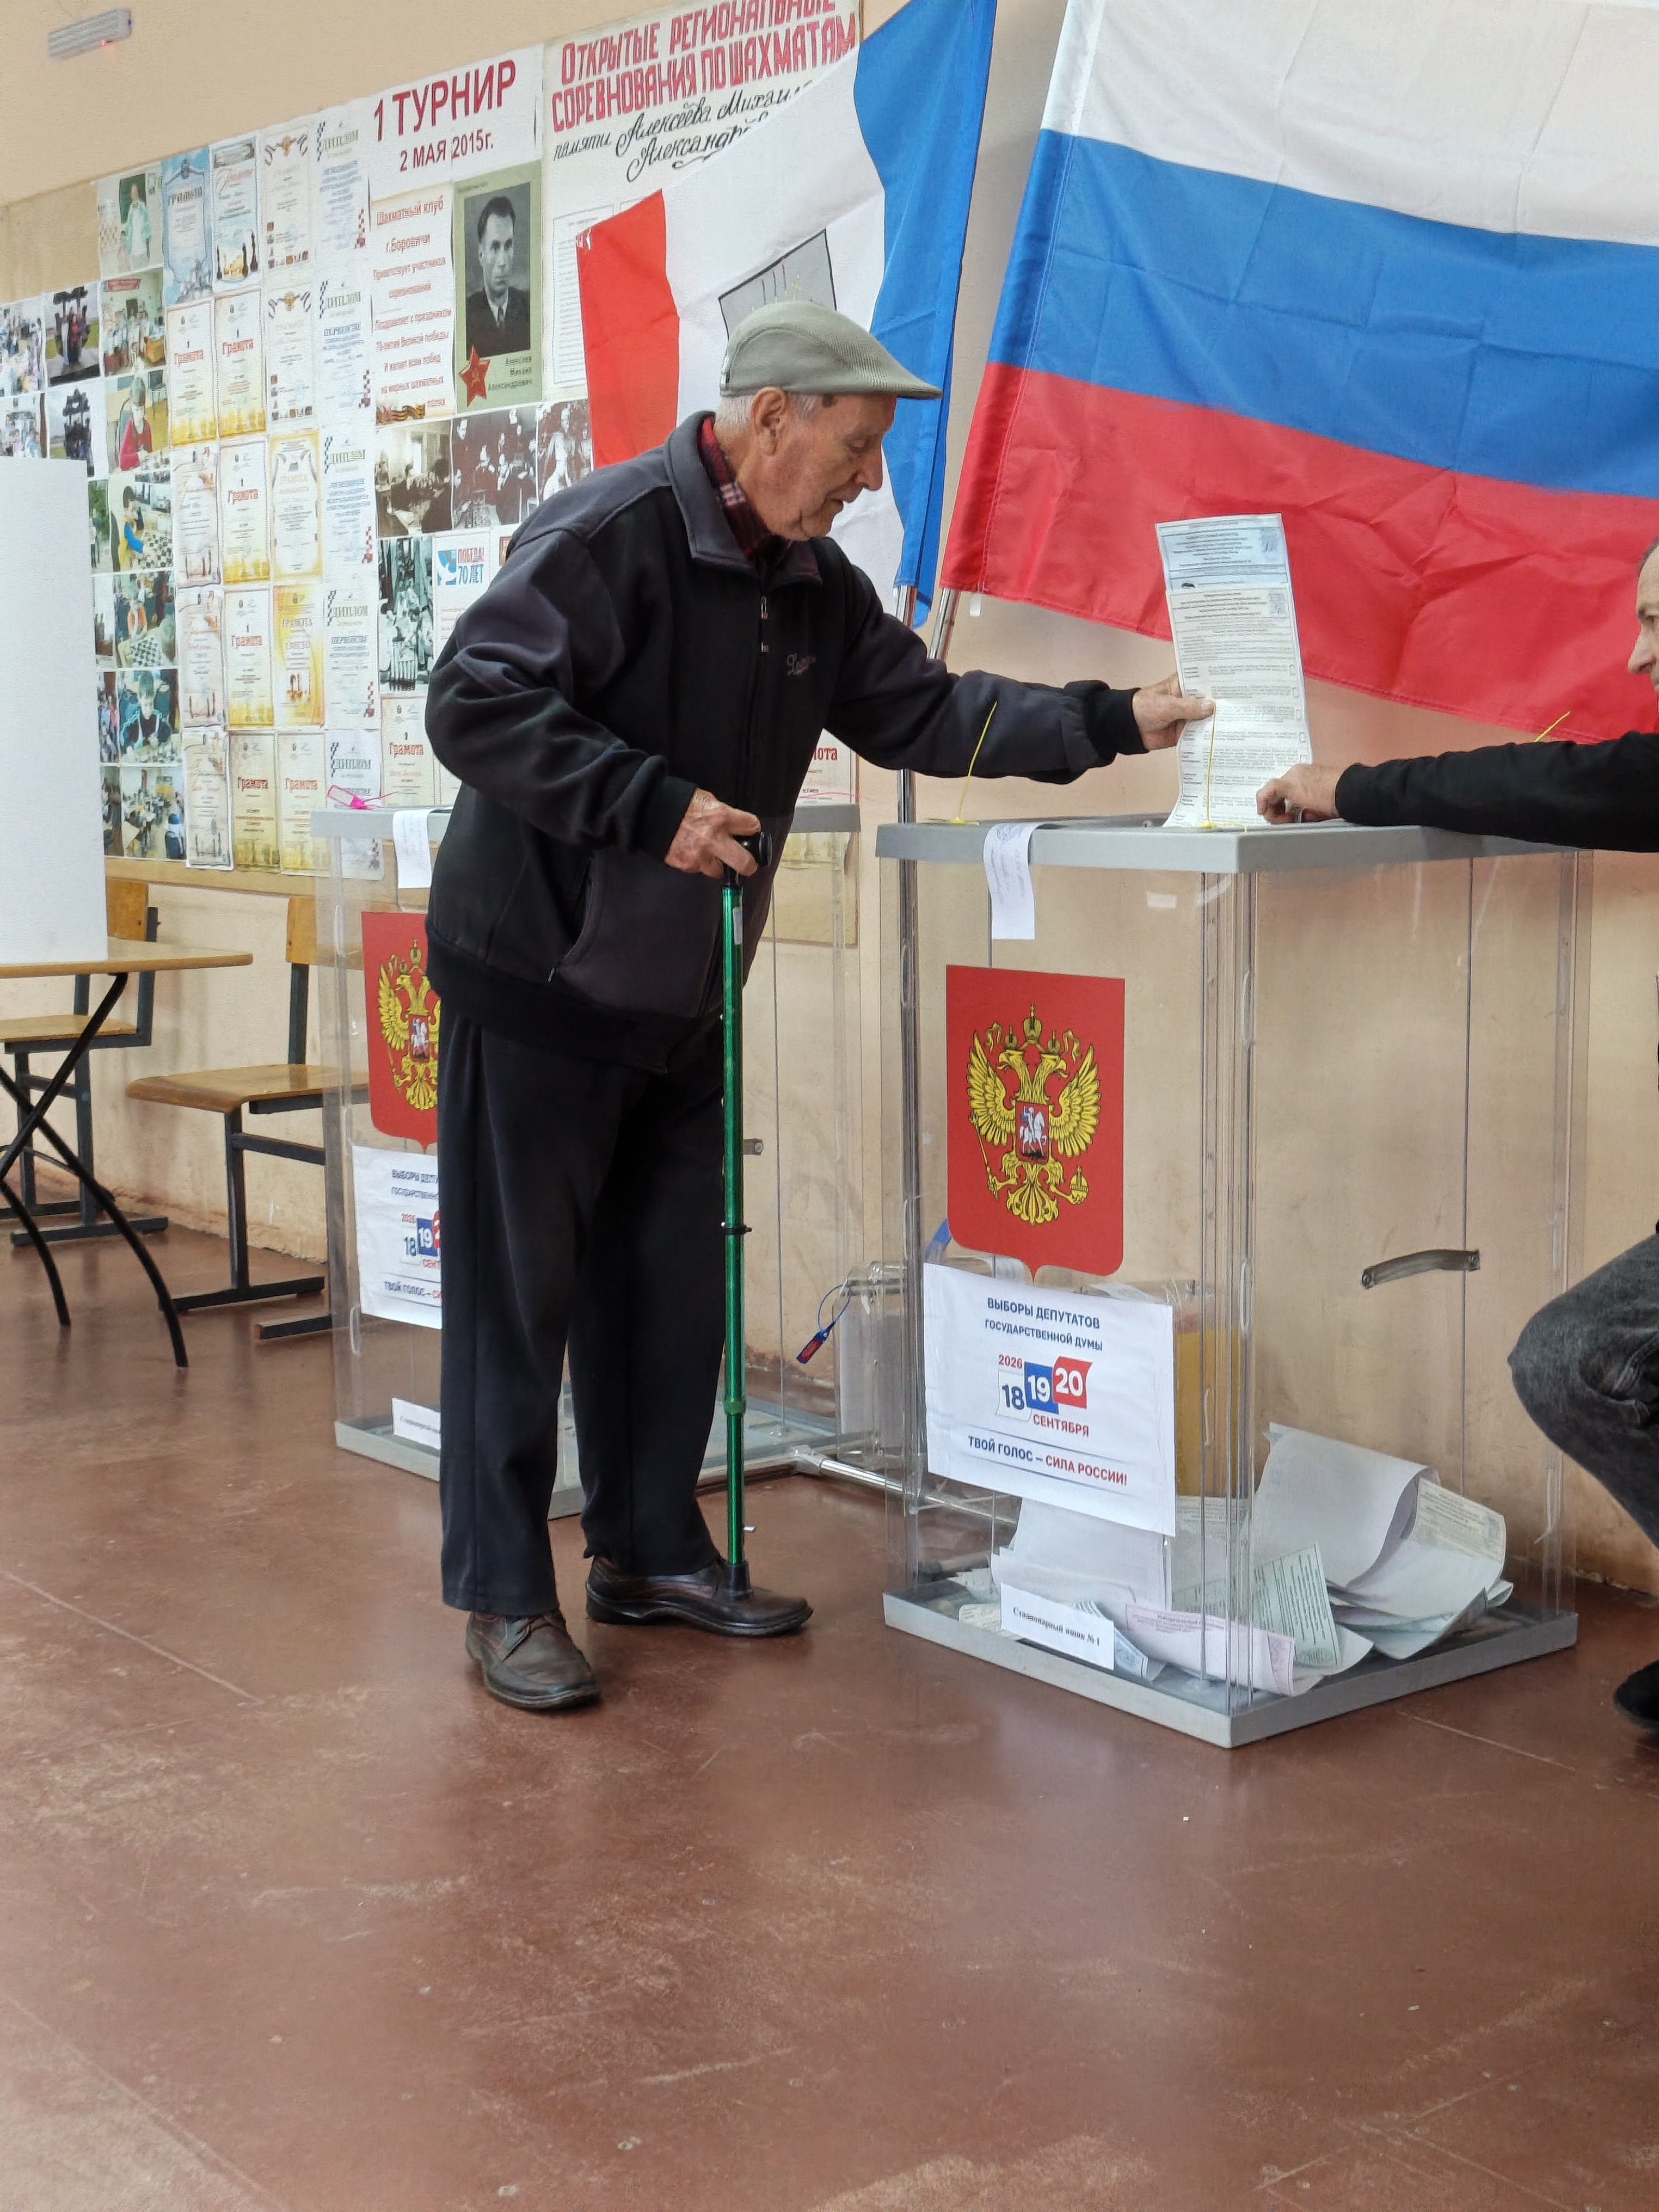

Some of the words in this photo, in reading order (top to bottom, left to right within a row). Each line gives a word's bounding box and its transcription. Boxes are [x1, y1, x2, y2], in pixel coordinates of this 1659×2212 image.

[551, 53, 697, 132] СОРЕВНОВАНИЯ
[729, 13, 856, 87] ШАХМАТАМ
[374, 99, 384, 142] 1
[392, 59, 516, 136] ТУРНИР
[400, 150, 408, 172] 2
[413, 140, 447, 169] МАЯ
[404, 1237, 416, 1256] 18
[419, 1227, 433, 1249] 19
[434, 1219, 440, 1240] 2
[987, 1297, 1034, 1317] ВЫБОРЫ
[1036, 1307, 1100, 1329] ДЕПУТАТОВ
[985, 1318, 1073, 1345] ГОСУДАРСТВЕННОЙ
[1075, 1337, 1103, 1351] ДУМЫ
[998, 1354, 1023, 1368] 2026
[1002, 1384, 1025, 1410] 18
[1027, 1374, 1051, 1403] 19
[1054, 1367, 1084, 1397] 20
[1033, 1414, 1090, 1437] СЕНТЯБРЯ
[968, 1435, 996, 1453] ТВОЙ
[998, 1443, 1033, 1462] ГОЛОС
[1045, 1455, 1075, 1473] СИЛА
[1078, 1464, 1127, 1486] РОССИИ!
